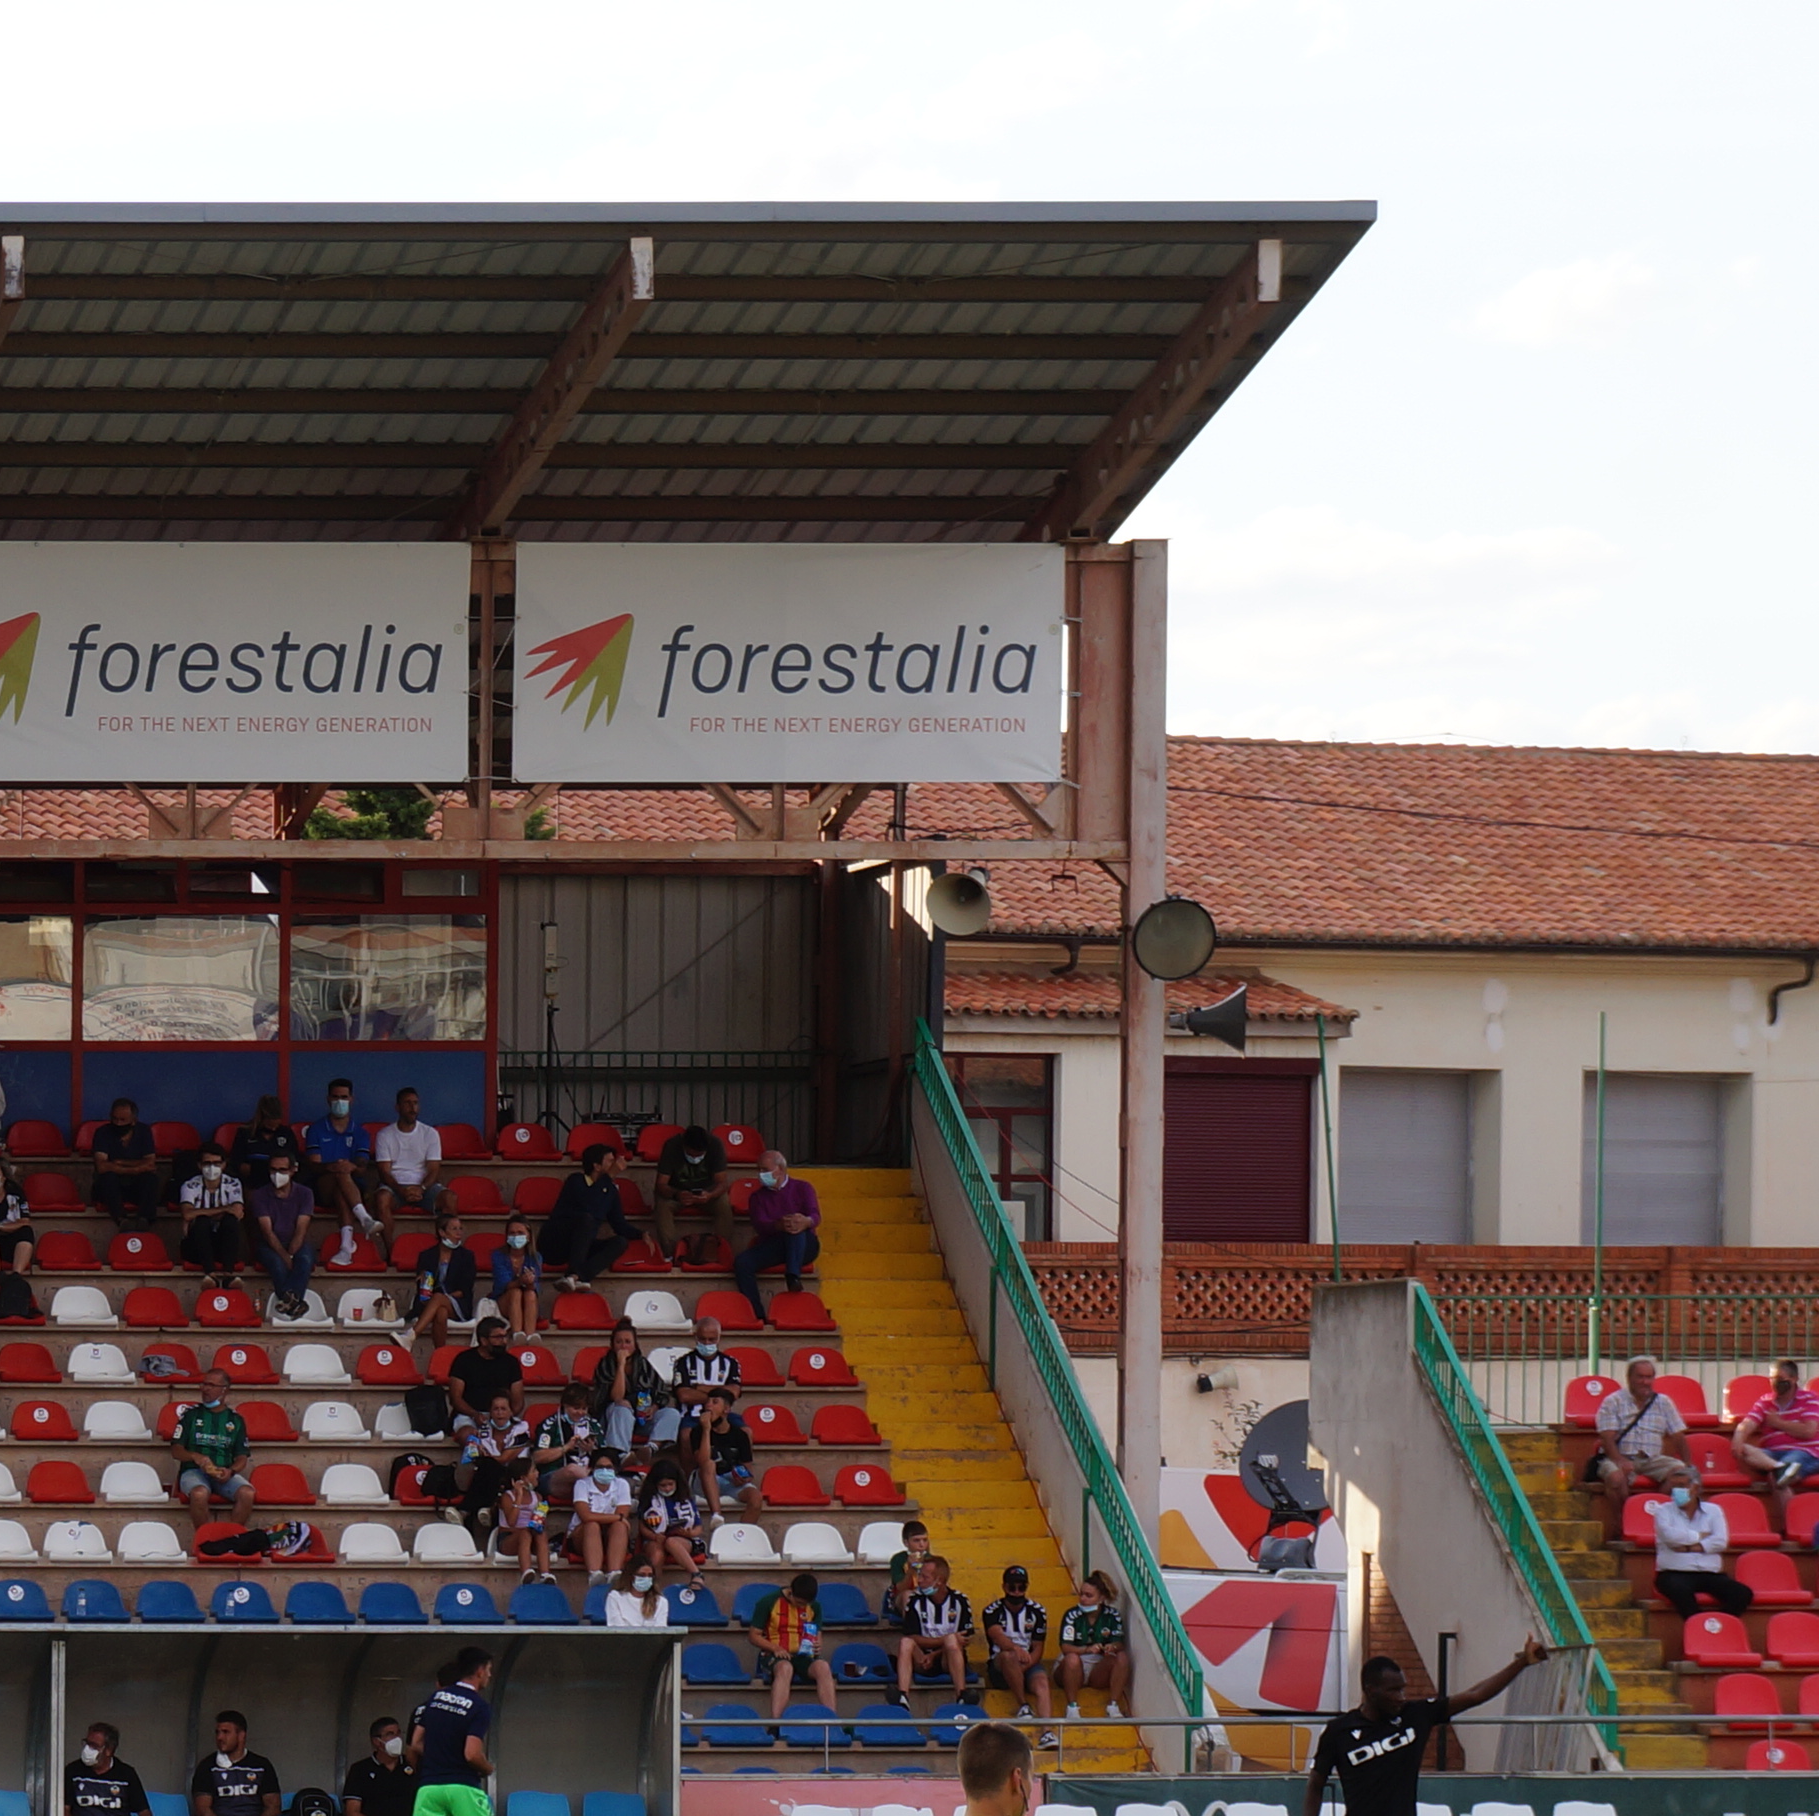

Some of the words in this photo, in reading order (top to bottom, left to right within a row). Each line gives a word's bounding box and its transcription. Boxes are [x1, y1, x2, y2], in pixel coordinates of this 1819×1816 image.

[65, 624, 443, 717] forestalia
[658, 625, 1037, 718] forestalia
[99, 716, 132, 731] FOR
[140, 717, 175, 732] THE
[183, 717, 230, 732] NEXT
[237, 717, 310, 733] ENERGY
[316, 717, 432, 733] GENERATION
[690, 717, 725, 732] FOR
[731, 717, 767, 732] THE
[775, 717, 822, 732] NEXT
[829, 717, 901, 733] ENERGY
[909, 717, 1026, 733] GENERATION
[1346, 1728, 1416, 1766] DIGI
